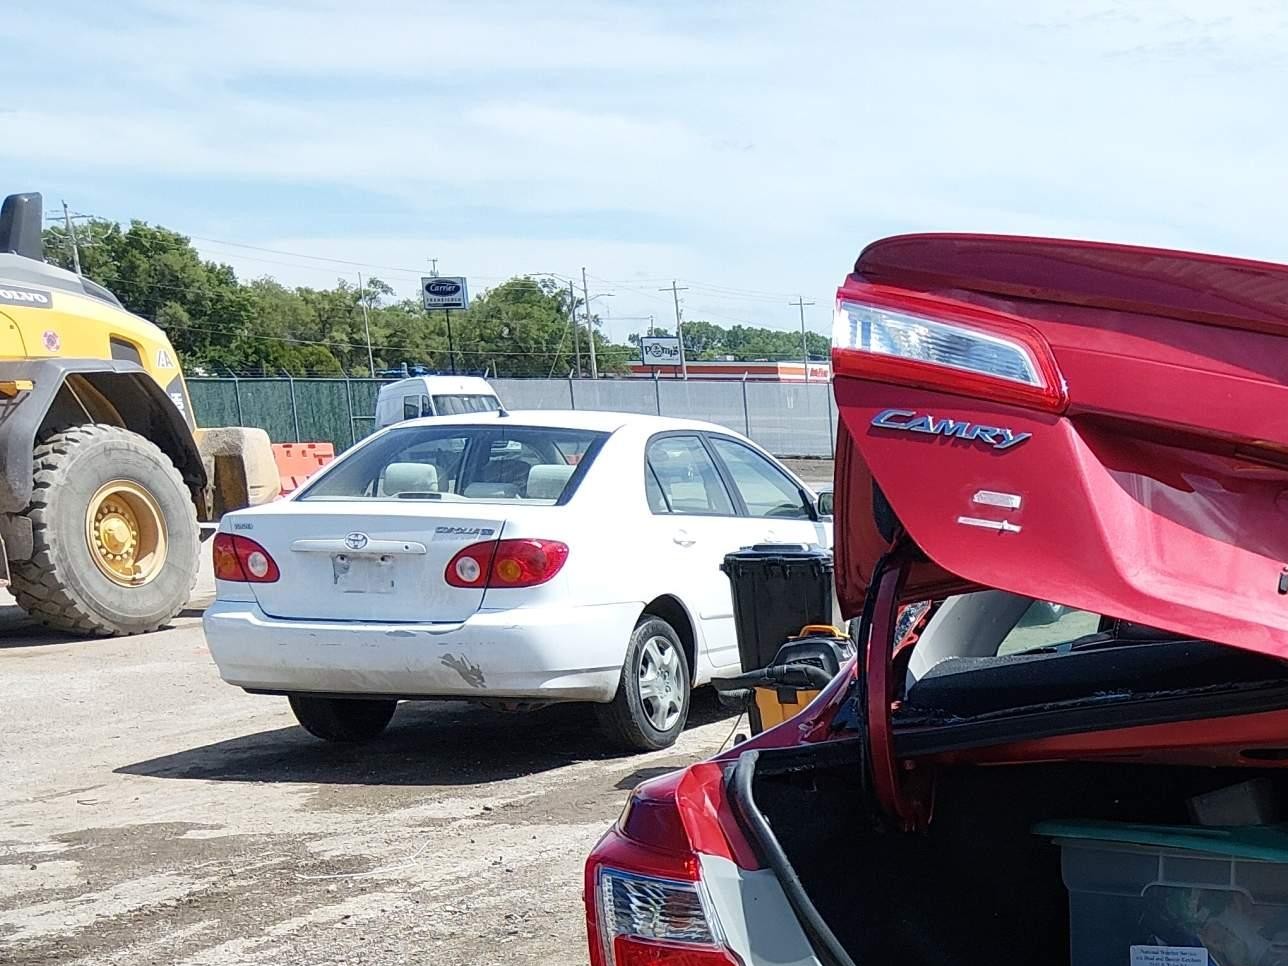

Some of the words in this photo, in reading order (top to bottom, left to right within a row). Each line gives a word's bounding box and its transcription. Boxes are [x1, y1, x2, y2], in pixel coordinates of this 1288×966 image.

[430, 283, 456, 292] Carrier
[0, 289, 48, 303] OLVO
[871, 408, 1033, 450] CAMRY
